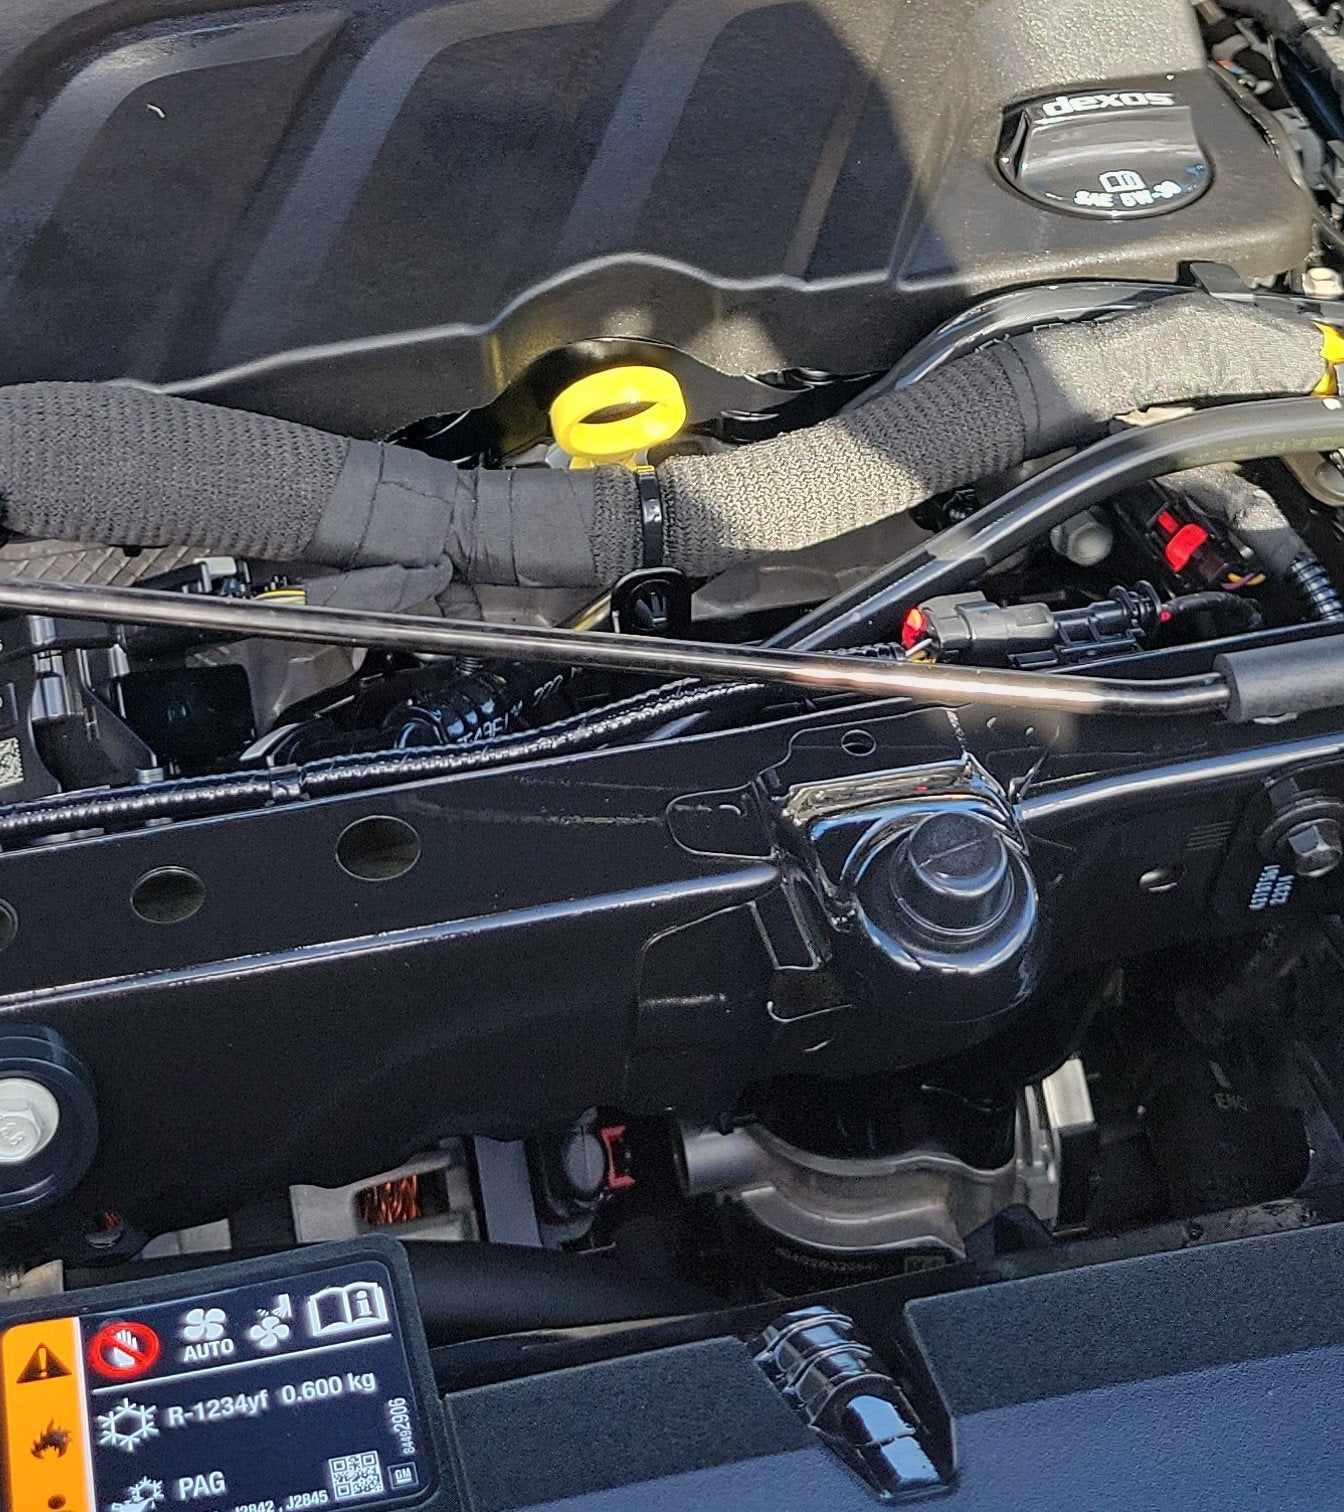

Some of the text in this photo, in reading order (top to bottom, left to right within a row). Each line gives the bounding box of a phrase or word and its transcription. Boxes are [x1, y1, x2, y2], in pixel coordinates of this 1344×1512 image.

[1041, 91, 1176, 118] dexos
[1073, 189, 1116, 209] SAE
[183, 1338, 235, 1363] AUTO
[166, 1372, 377, 1428] R-1234yf 0.600 kg
[178, 1471, 227, 1500] PAG
[285, 1489, 330, 1511] J2845
